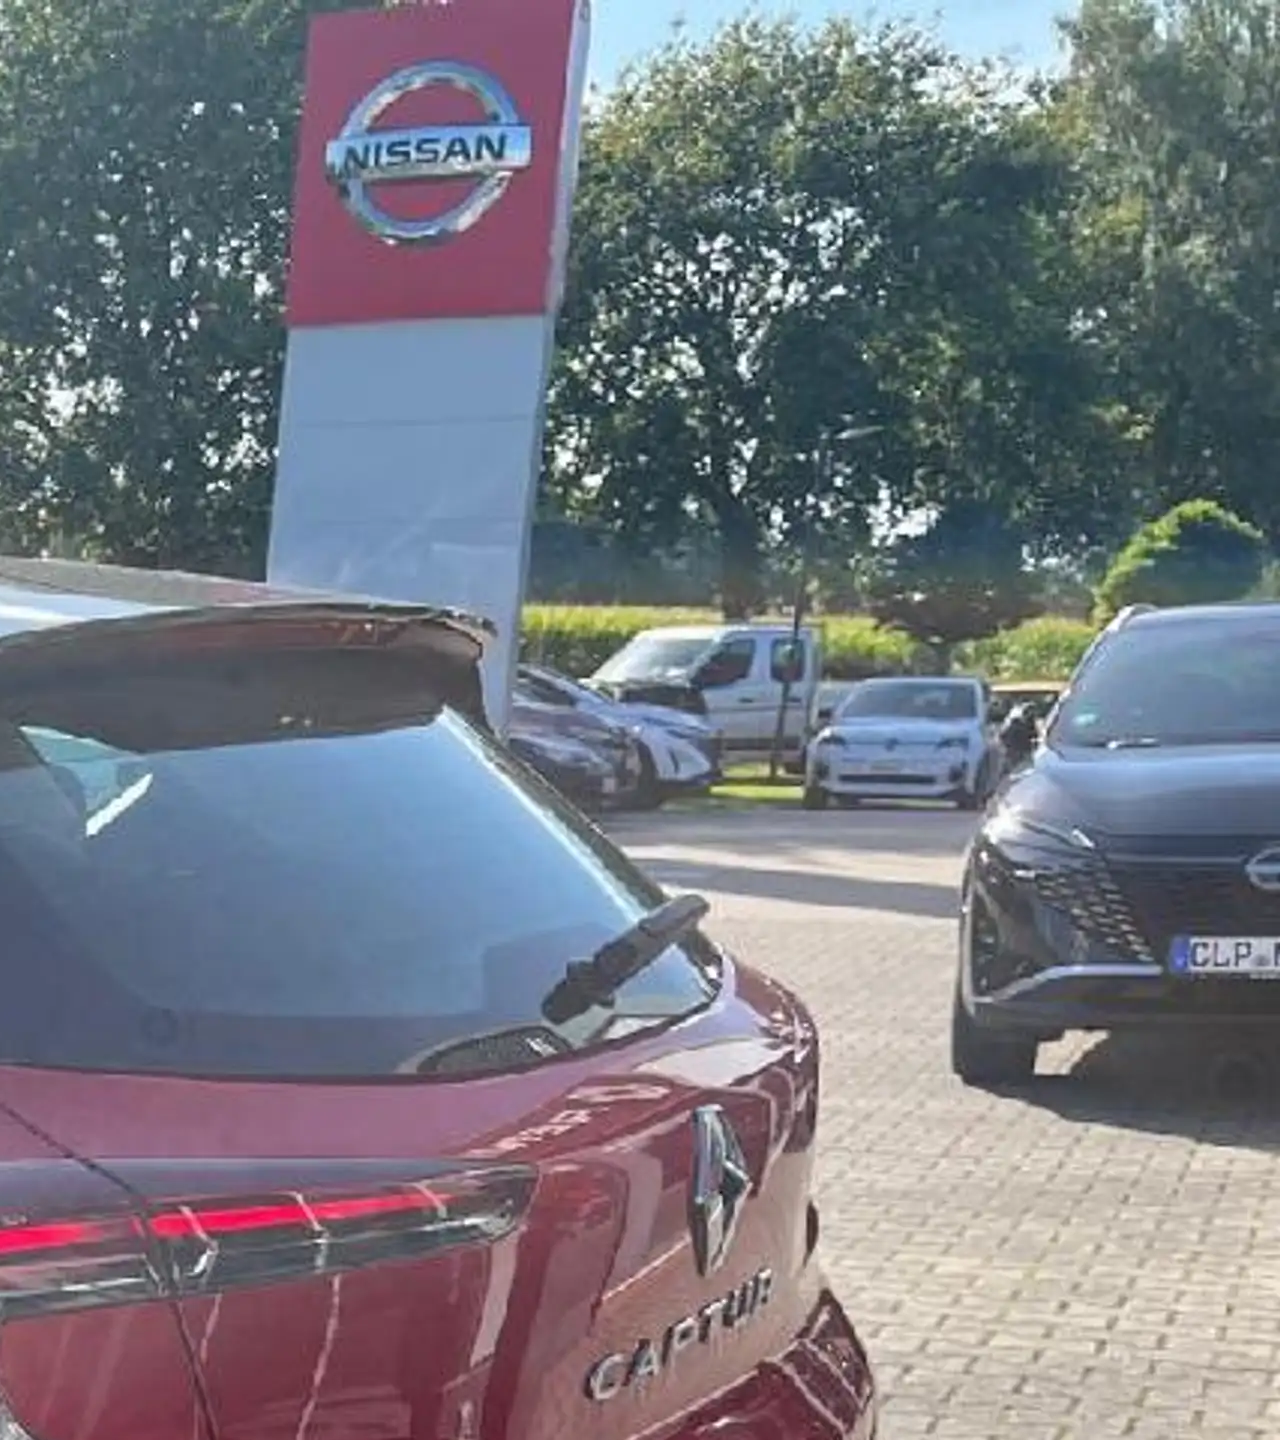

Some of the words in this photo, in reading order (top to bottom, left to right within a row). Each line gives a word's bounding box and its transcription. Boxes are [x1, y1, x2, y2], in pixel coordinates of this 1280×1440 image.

[343, 132, 508, 171] NISSAN
[1190, 941, 1252, 968] CLP
[584, 1267, 773, 1401] CAPTUR
